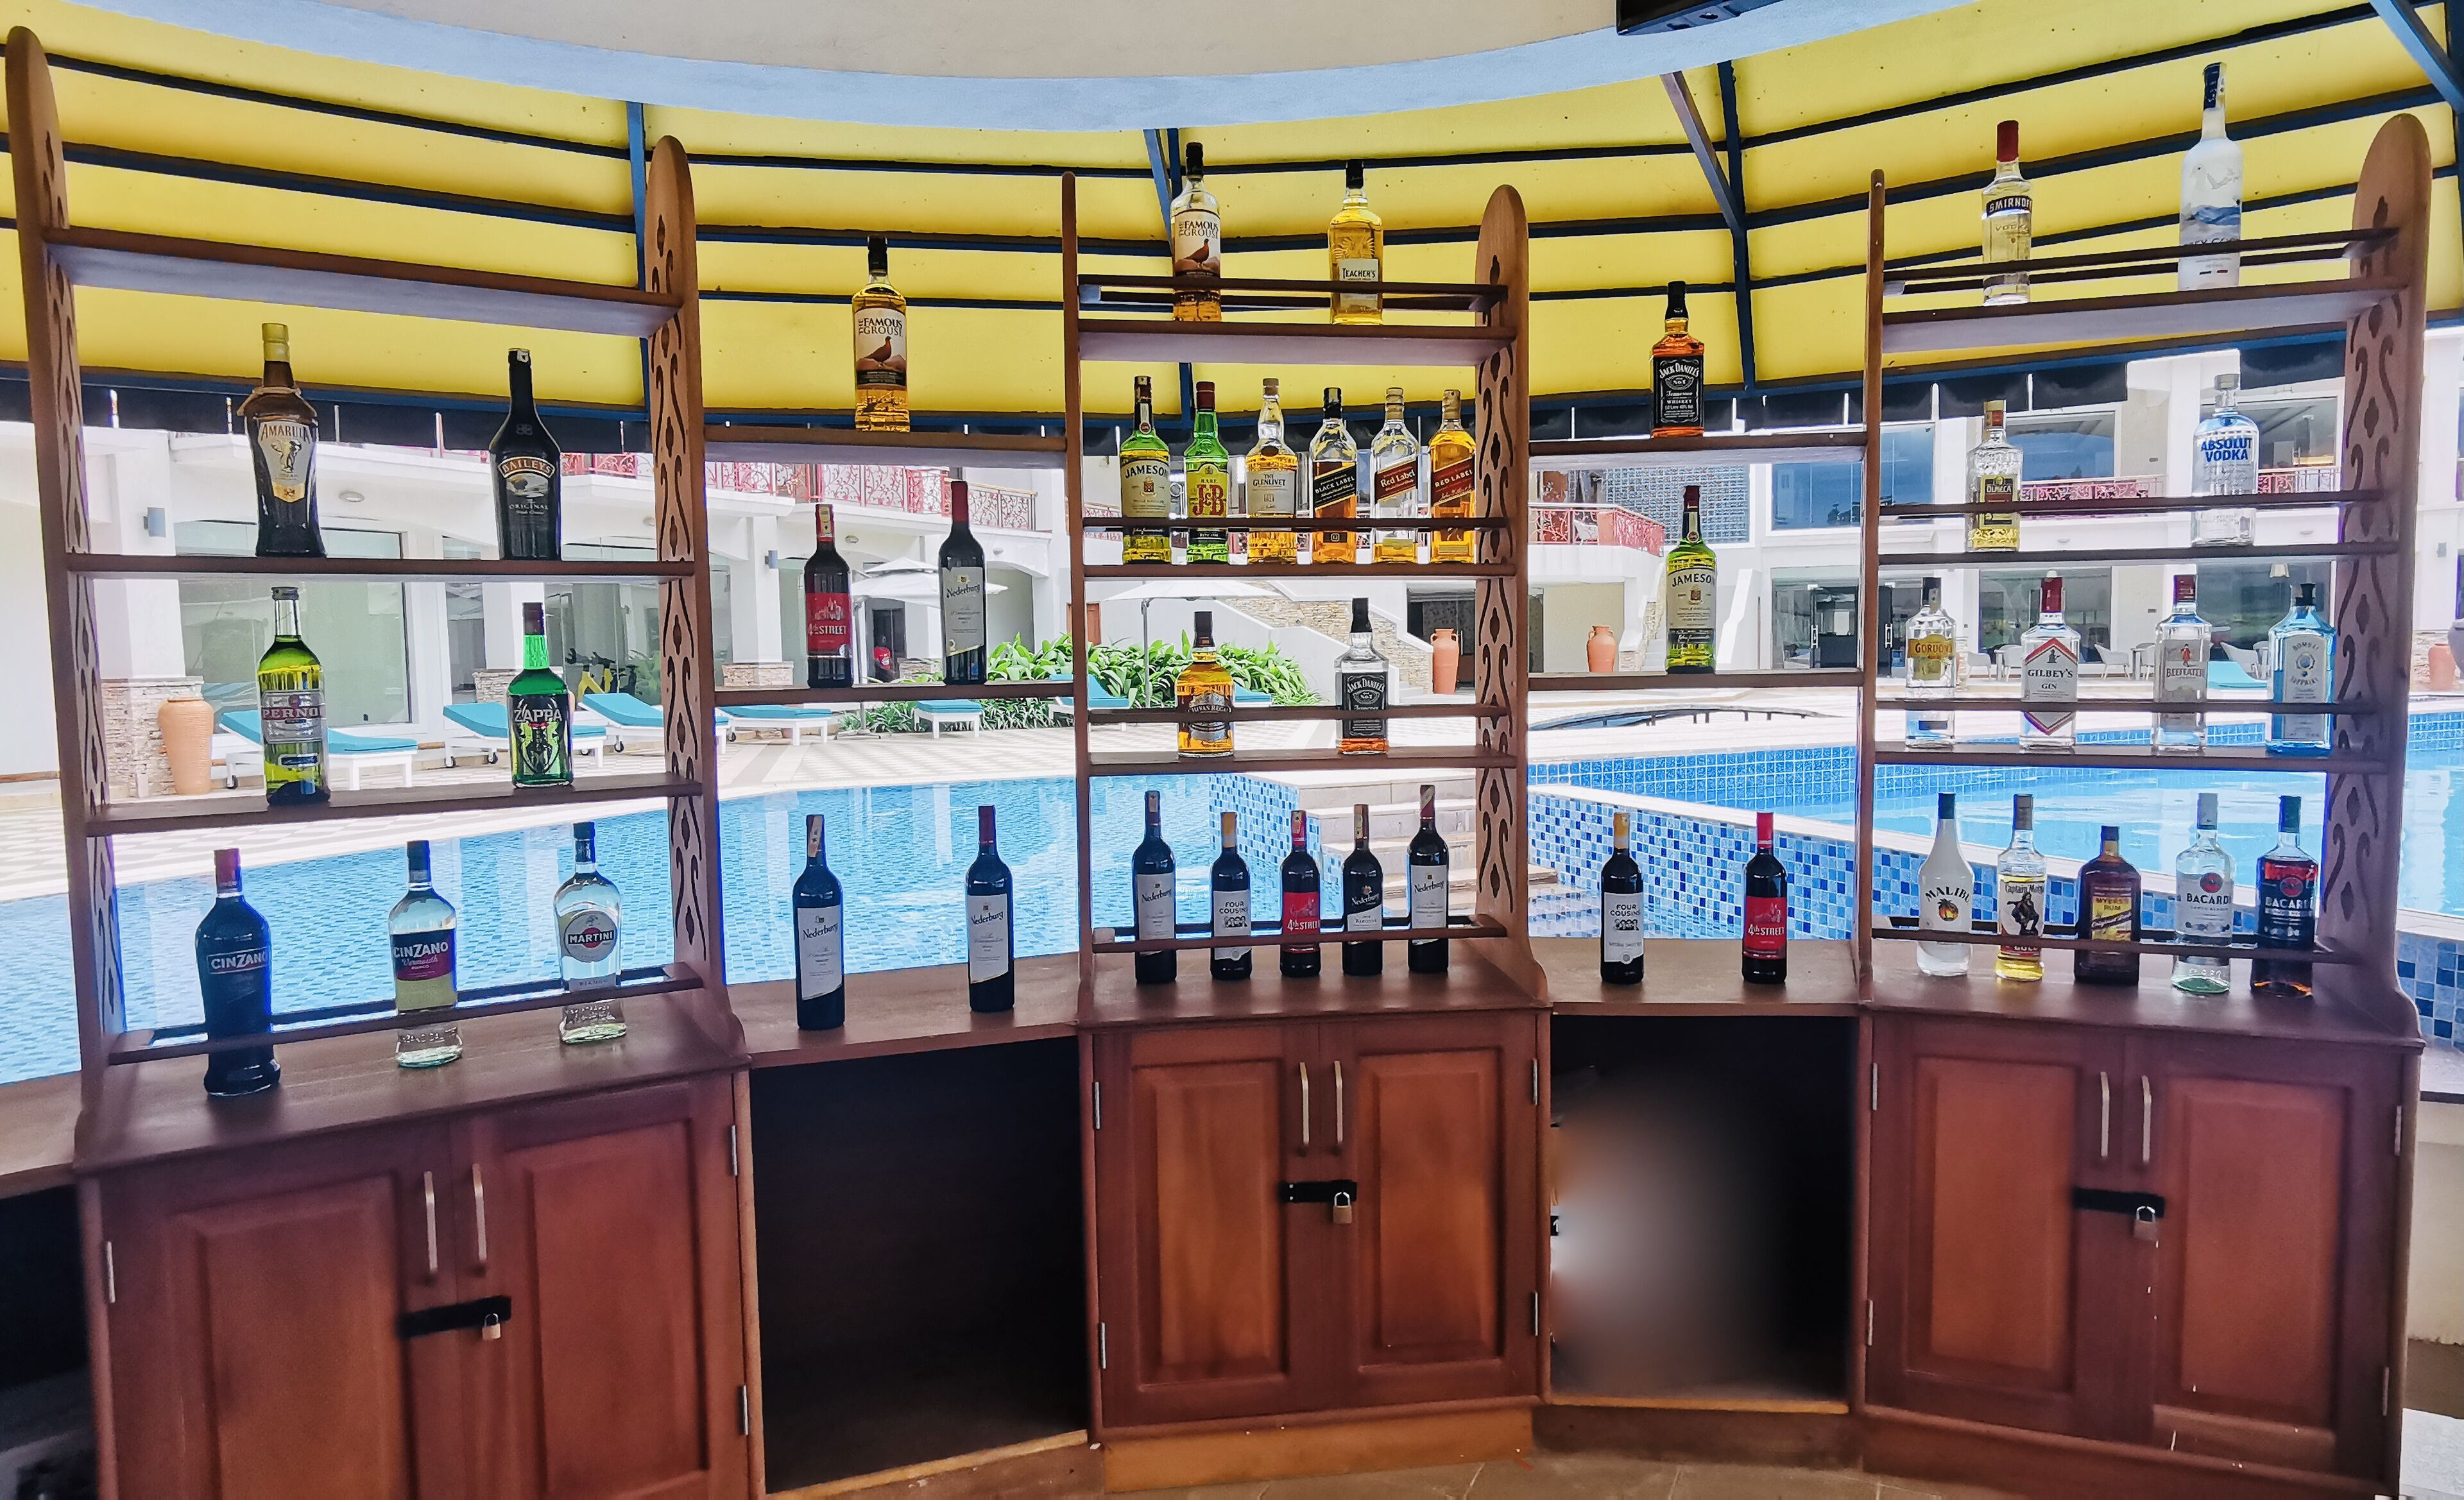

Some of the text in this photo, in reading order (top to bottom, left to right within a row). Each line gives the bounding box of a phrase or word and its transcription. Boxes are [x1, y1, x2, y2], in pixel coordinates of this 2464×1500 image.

[1184, 220, 1219, 231] FAMOUS
[1342, 267, 1376, 279] TEACHER'S
[864, 317, 903, 329] FAMOUS
[1659, 362, 1700, 379] JACK DANIEL'S
[2200, 437, 2253, 452] ABSOLUT
[2205, 449, 2249, 462] VODKA
[503, 459, 552, 473] BAILEYS
[1434, 469, 1473, 487] RED LABEL
[1315, 482, 1335, 494] BLACK
[1336, 475, 1355, 487] LABEL
[818, 625, 847, 635] STREET
[2027, 668, 2074, 679] GILBEY'S
[1347, 682, 1362, 694] JACK
[262, 708, 321, 719] PERNO
[513, 708, 563, 723] ZAPPA
[2005, 884, 2028, 894] Captain
[970, 910, 1004, 925] Nederburg
[1748, 924, 1760, 935] 4th
[569, 931, 613, 943] MARTINI
[393, 942, 449, 959] CINZANO
